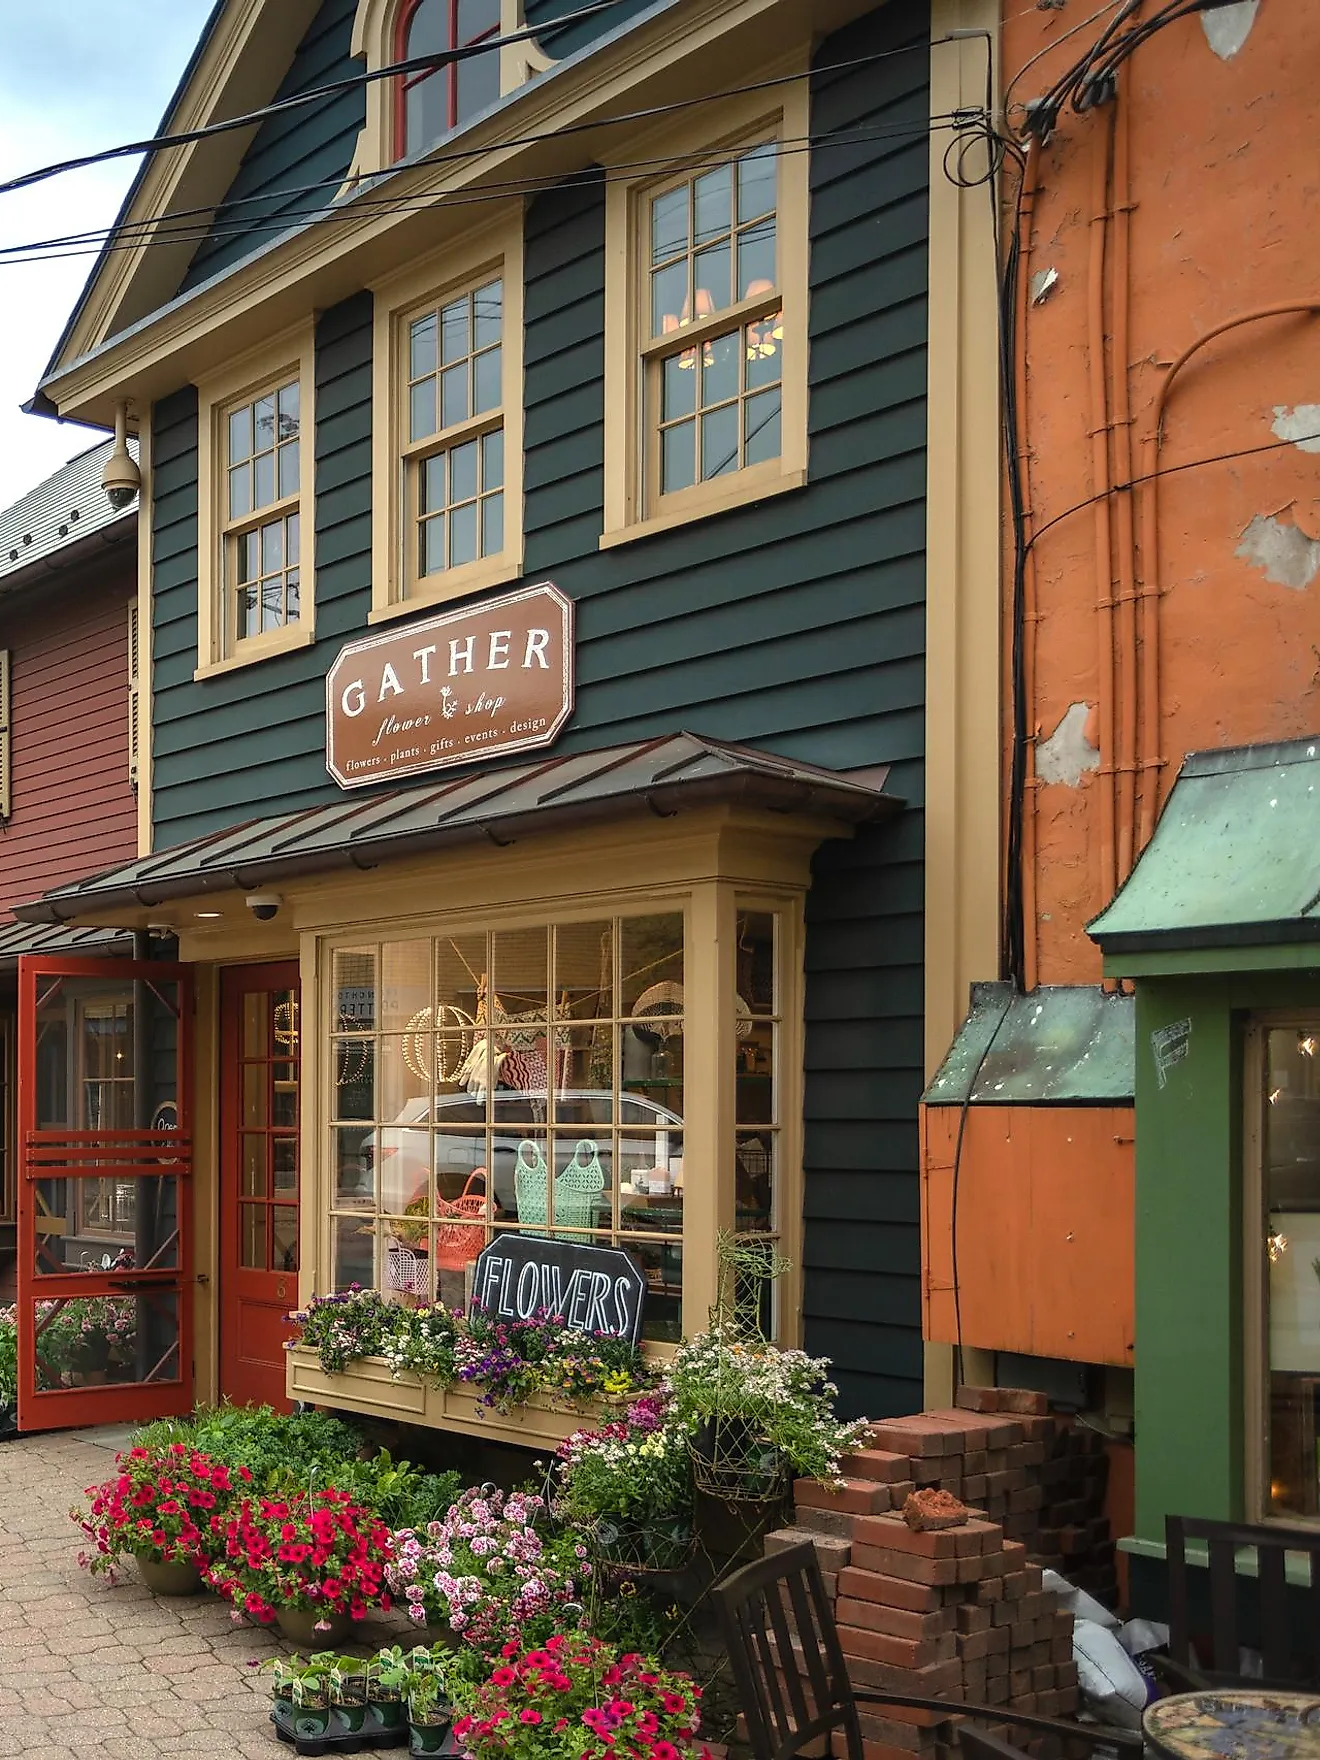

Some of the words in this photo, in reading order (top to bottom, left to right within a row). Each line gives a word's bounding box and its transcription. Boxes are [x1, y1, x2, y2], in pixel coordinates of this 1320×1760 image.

[342, 629, 549, 717] GATHER
[346, 757, 381, 771] flowers
[390, 744, 420, 763] plants
[430, 737, 454, 755] gifts
[464, 729, 498, 744] events
[509, 717, 546, 734] design
[372, 714, 432, 746] flower
[465, 692, 507, 717] shop
[481, 1256, 631, 1336] FLOWERS
